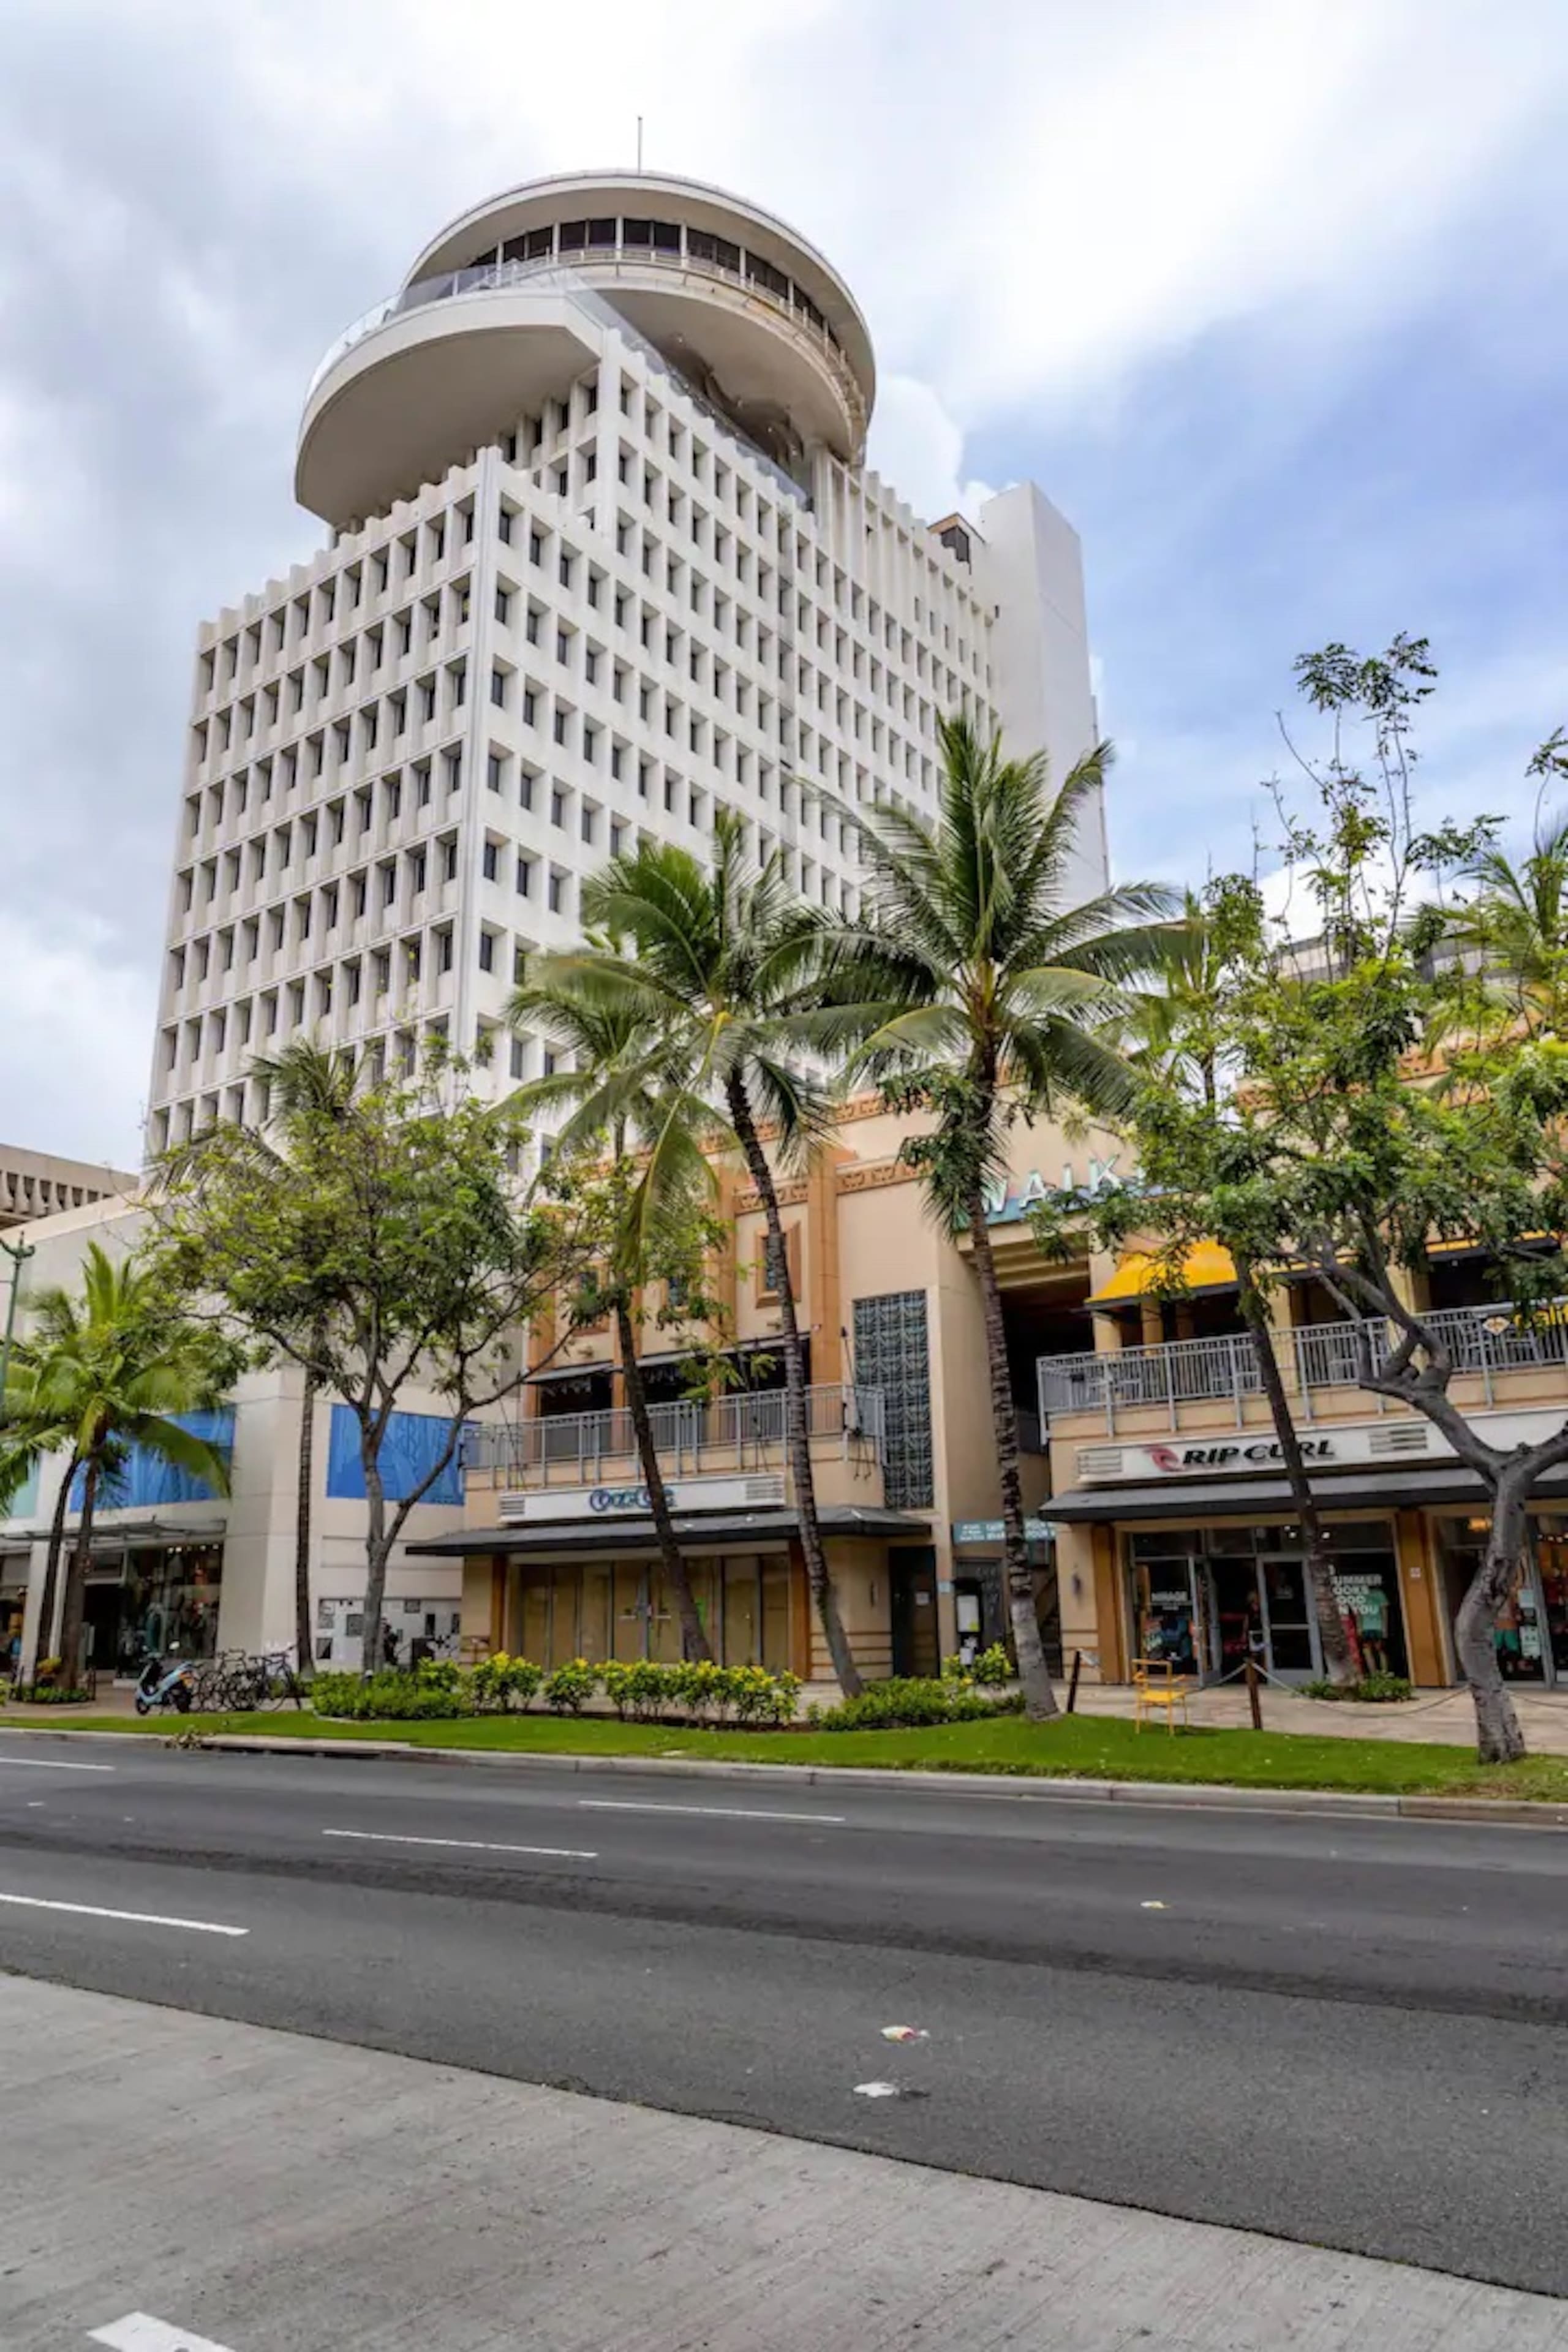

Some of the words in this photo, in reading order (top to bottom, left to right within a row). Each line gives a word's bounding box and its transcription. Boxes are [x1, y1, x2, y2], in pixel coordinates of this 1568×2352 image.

[981, 1154, 1144, 1213] WAIK
[1182, 1447, 1239, 1464] RIP
[1330, 1574, 1382, 1586] UMMER
[1332, 1585, 1370, 1595] OOKS
[1350, 1604, 1379, 1615] YOU
